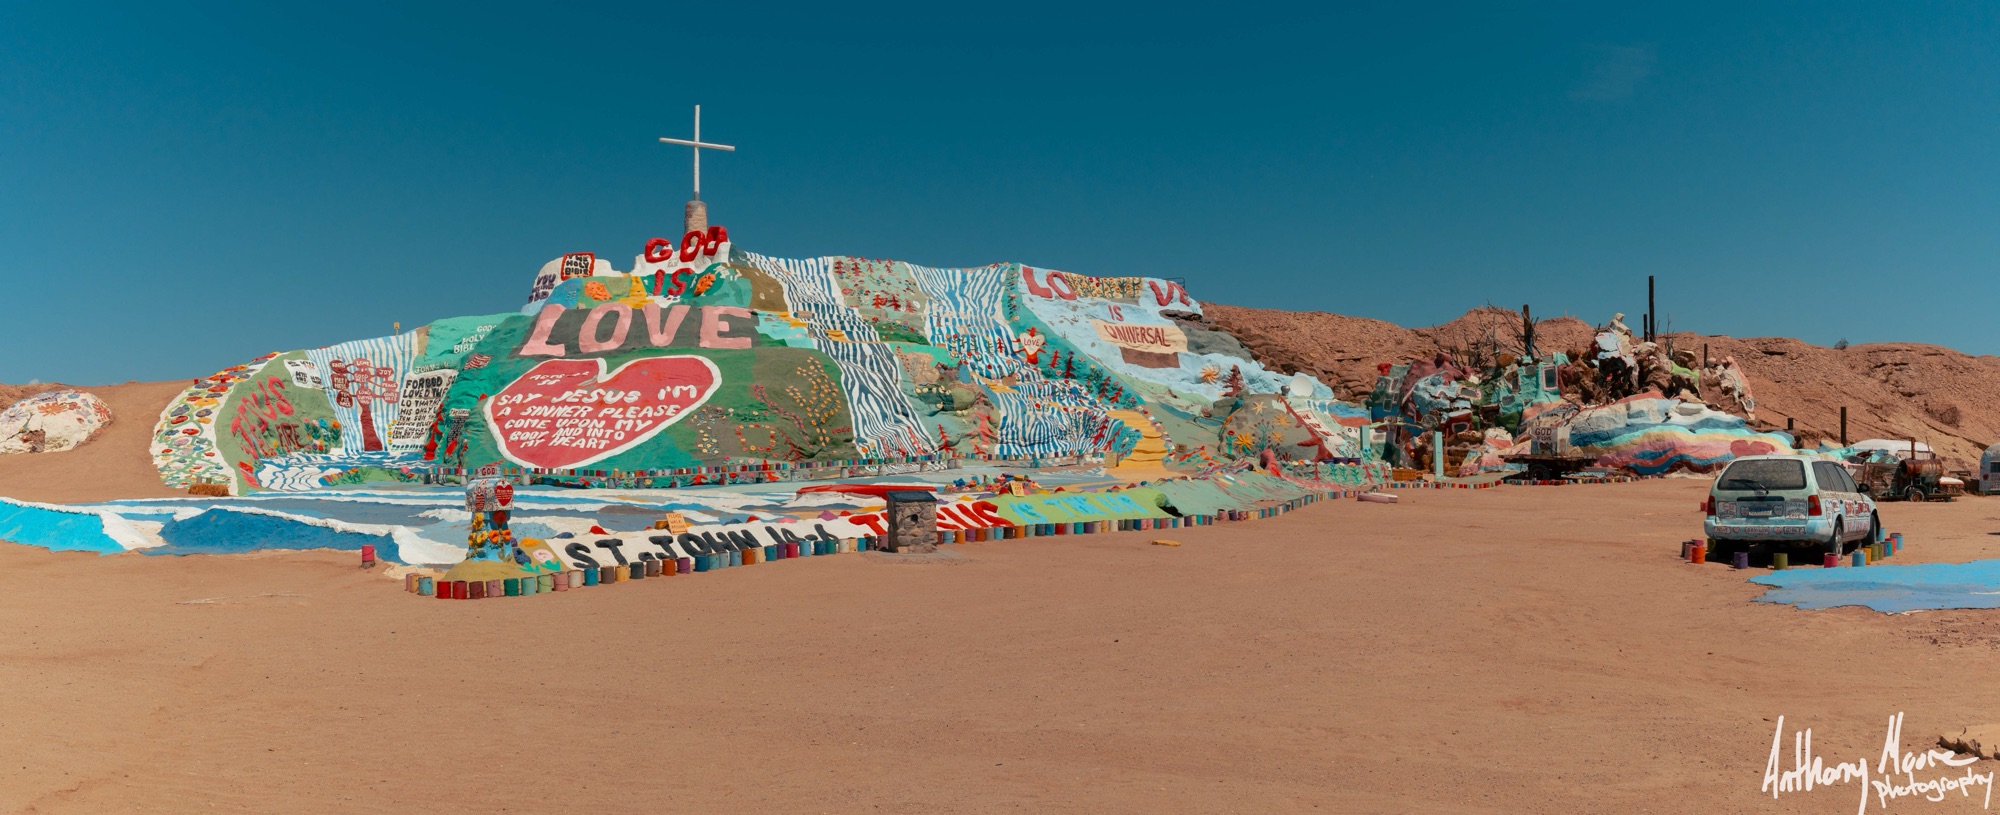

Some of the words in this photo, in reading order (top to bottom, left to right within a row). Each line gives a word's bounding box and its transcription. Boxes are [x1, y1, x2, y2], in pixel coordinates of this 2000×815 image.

[645, 226, 728, 262] GOD
[566, 261, 589, 269] HOLY
[536, 273, 556, 286] YOU
[653, 268, 694, 296] IS
[1107, 304, 1124, 321] IS
[519, 303, 752, 356] LOVE
[1103, 324, 1171, 347] UNIVERSAL
[462, 334, 485, 344] HOLY
[1023, 338, 1041, 347] LOVE
[453, 344, 475, 354] BIBL
[403, 389, 430, 398] LOVED
[497, 393, 542, 406] SAY
[550, 389, 641, 404] JESUS
[657, 384, 697, 400] I'M
[497, 407, 511, 416] A
[520, 405, 594, 418] SINNER
[598, 405, 681, 418] PLEASE
[505, 418, 551, 430] COME
[555, 418, 605, 430] UPON
[614, 419, 653, 432] MY
[509, 431, 549, 442] BODY
[551, 428, 583, 438] AND
[586, 428, 625, 440] INTO
[520, 439, 545, 448] MY
[548, 436, 610, 449] HEART
[482, 468, 495, 476] GOD
[649, 528, 763, 560] JOHN
[1008, 502, 1048, 524] IS
